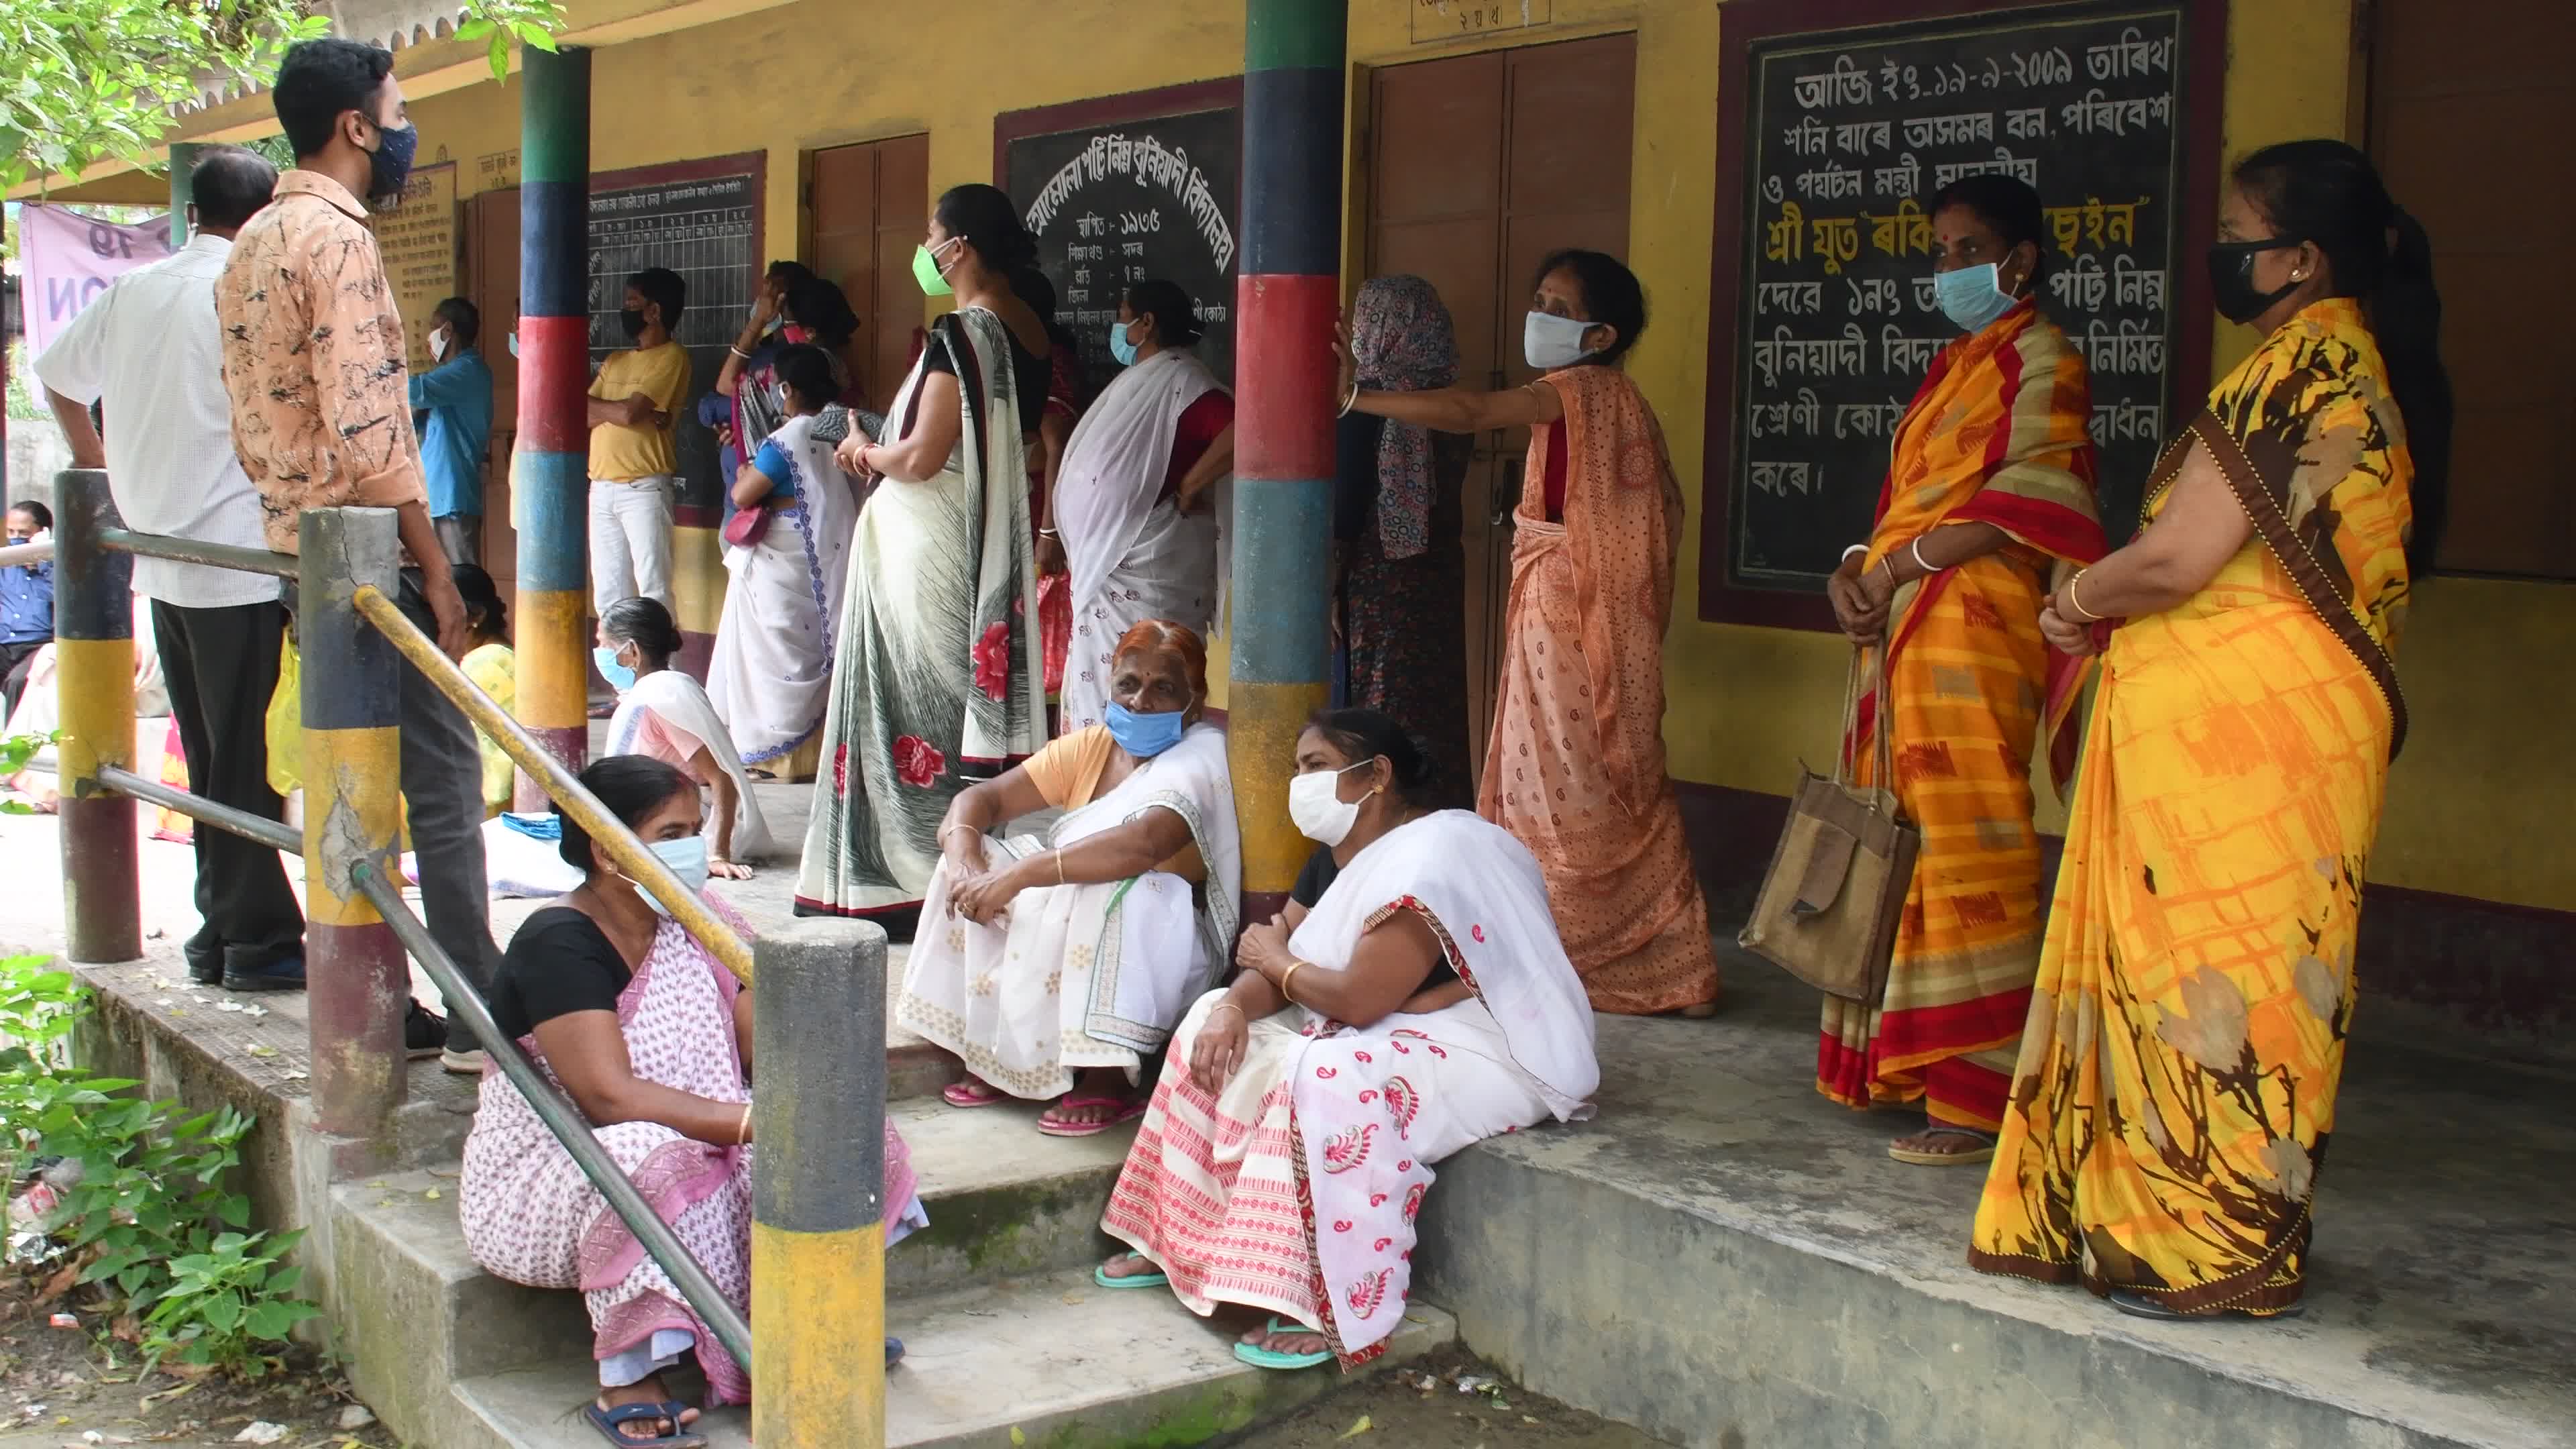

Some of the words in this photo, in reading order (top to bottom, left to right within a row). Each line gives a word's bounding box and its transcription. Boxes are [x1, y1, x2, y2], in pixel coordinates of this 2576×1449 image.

[1794, 54, 1874, 110] আজি
[2087, 27, 2174, 80] তাৰিখ
[1904, 111, 1994, 149] অসমৰ
[2061, 88, 2173, 136] পৰিবেশ
[1120, 209, 1161, 235] ১৯৩৫
